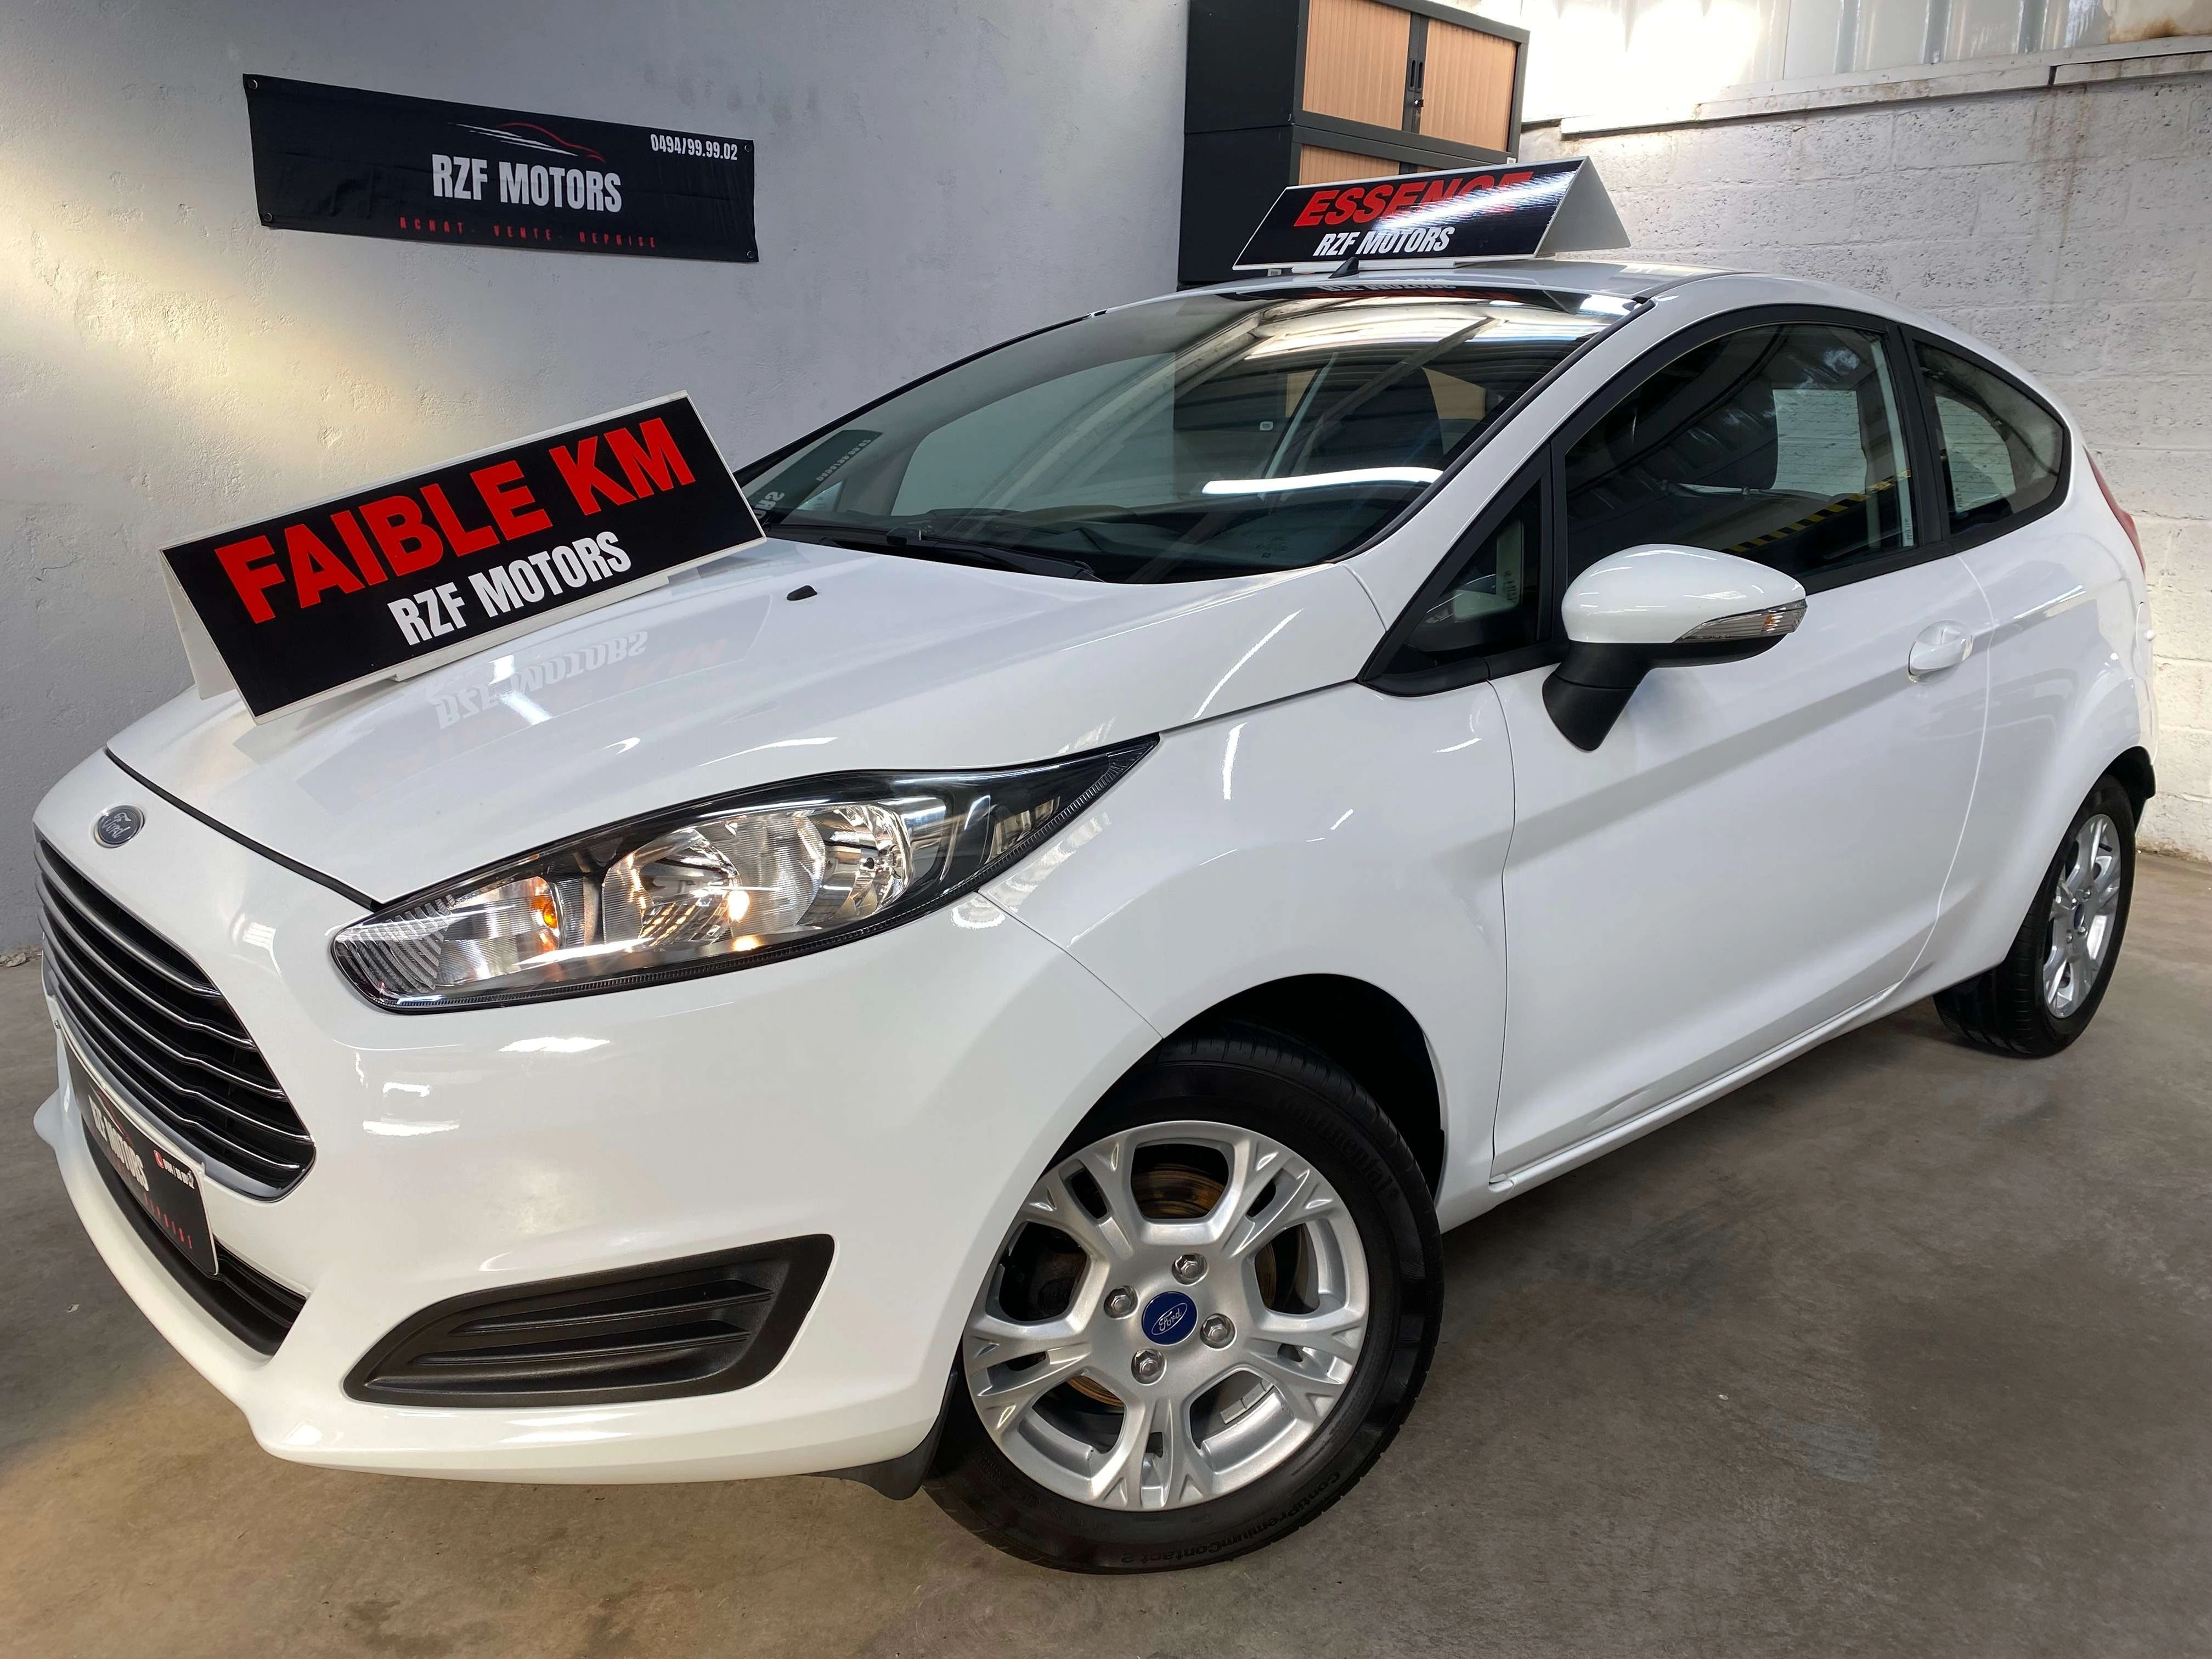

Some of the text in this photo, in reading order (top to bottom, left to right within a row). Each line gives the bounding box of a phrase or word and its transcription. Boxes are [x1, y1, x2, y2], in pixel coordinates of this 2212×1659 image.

[651, 134, 738, 161] 0494/99.99.02
[432, 153, 622, 213] RZF MOTORS
[399, 217, 656, 249] ACHAT VENTE REPRISE
[1313, 227, 1455, 256] RZF MOTORS
[215, 418, 696, 624] FAIBLE KM
[387, 531, 631, 646] RZF MOTORS
[1158, 1307, 1182, 1331] Ford
